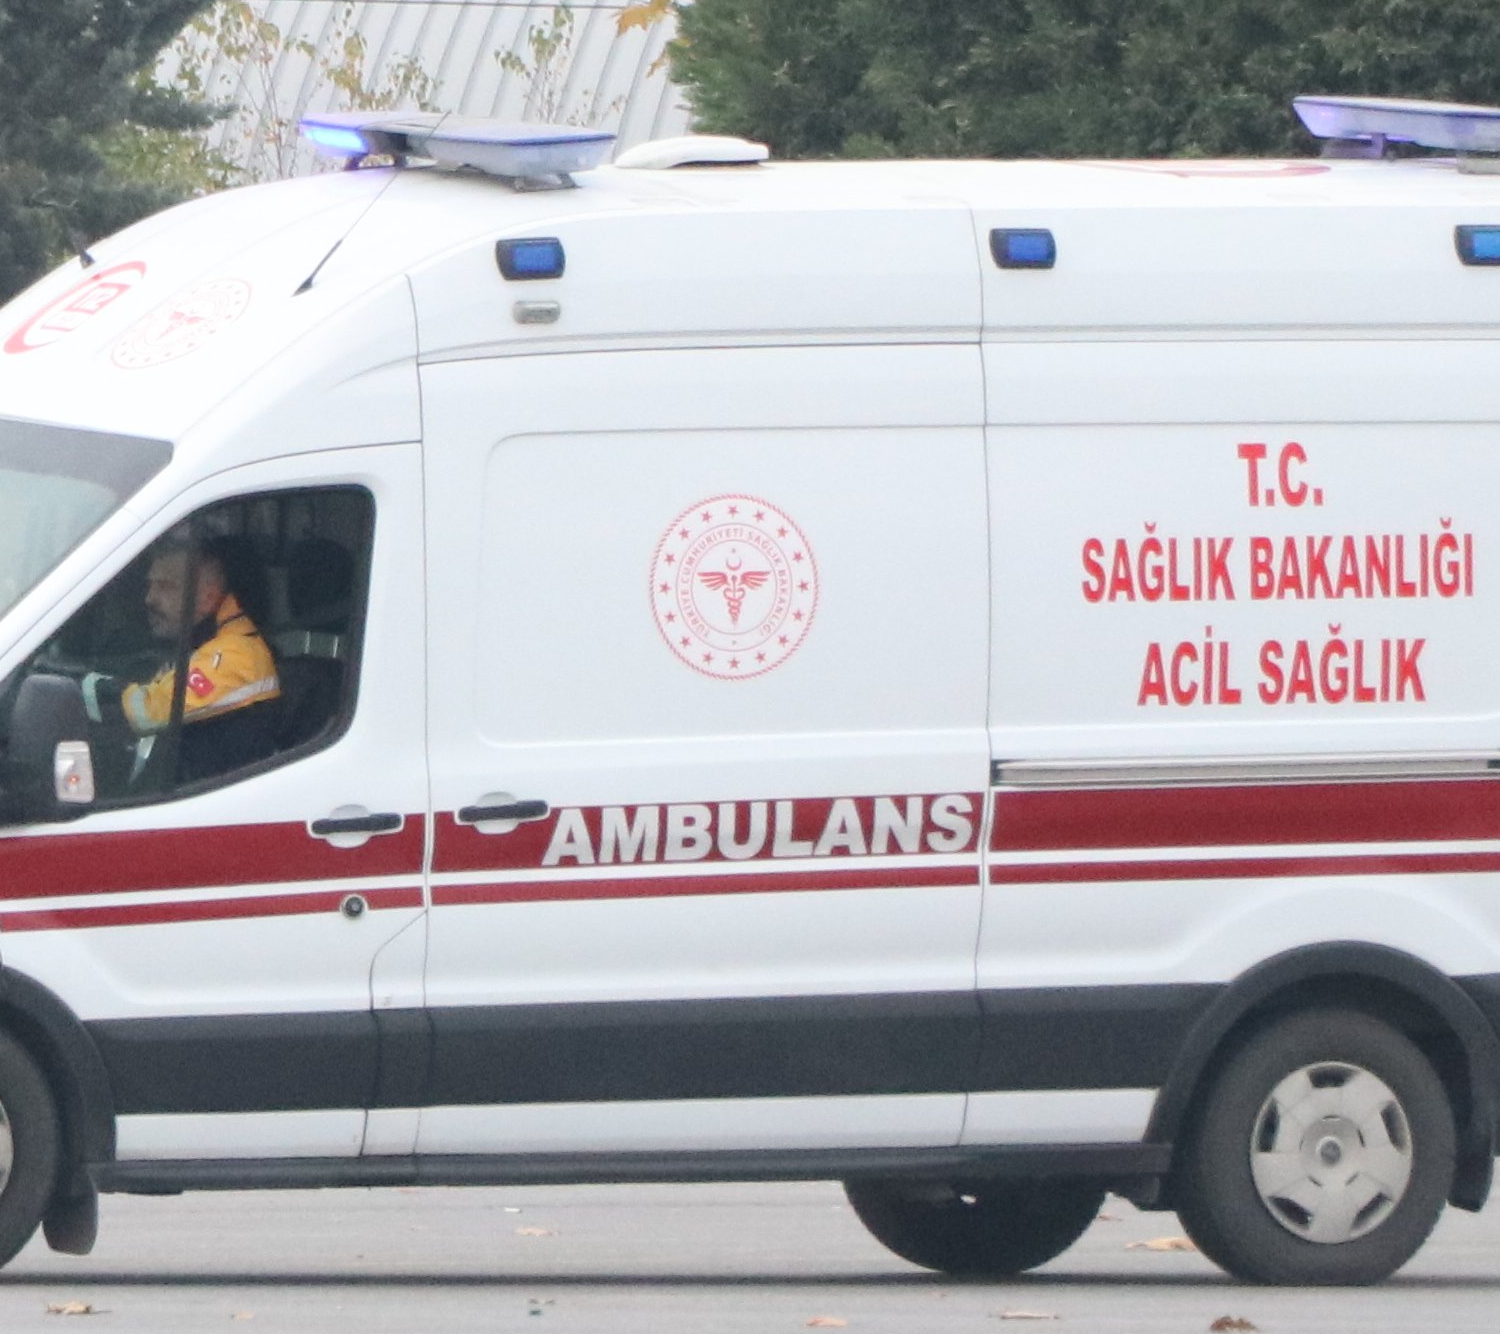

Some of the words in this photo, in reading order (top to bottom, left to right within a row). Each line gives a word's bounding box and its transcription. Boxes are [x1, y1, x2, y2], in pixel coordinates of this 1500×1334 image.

[1237, 442, 1324, 507] T.C.
[1081, 521, 1236, 603] SAĞLIK
[1249, 517, 1473, 600] BAKANLIĞI
[1137, 625, 1242, 706] ACİL
[1257, 623, 1427, 705] SAĞLIK
[541, 794, 974, 866] AMBULANS
